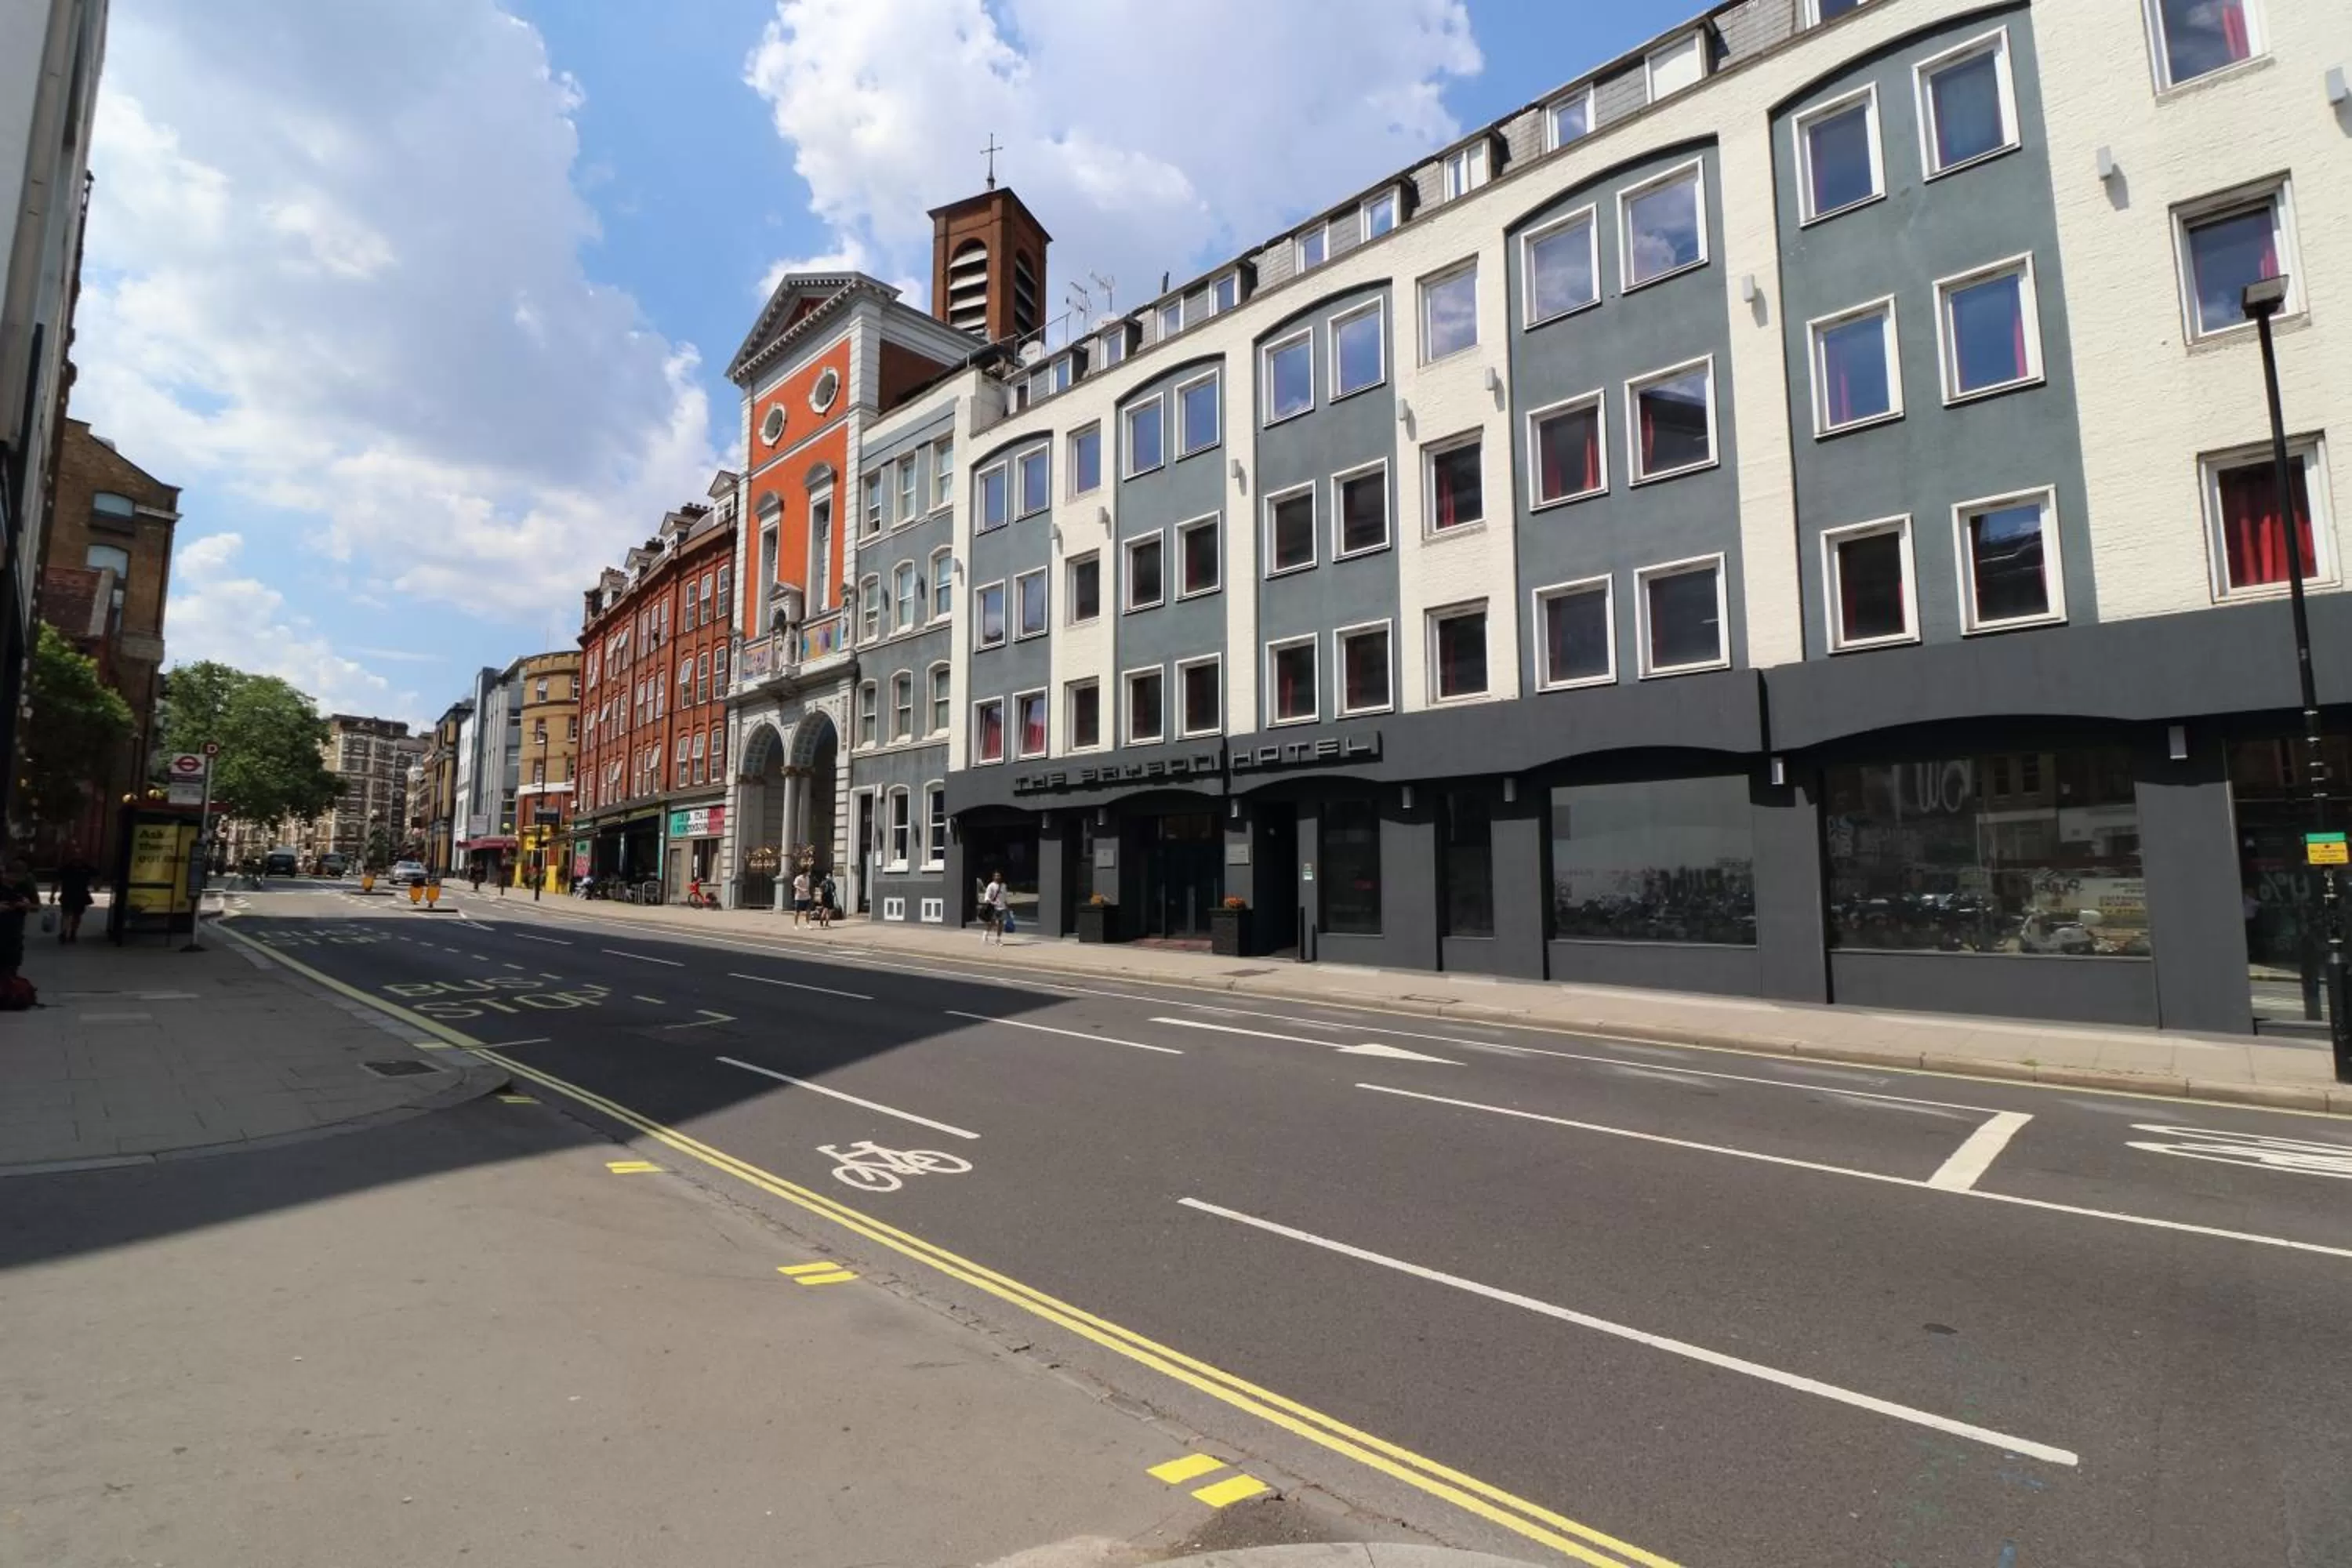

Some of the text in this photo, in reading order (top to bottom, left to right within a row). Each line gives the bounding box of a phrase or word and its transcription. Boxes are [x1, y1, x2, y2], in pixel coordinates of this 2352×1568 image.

[1232, 737, 1370, 768] HOTEL
[383, 977, 543, 996] BUS
[414, 989, 609, 1018] STOP
